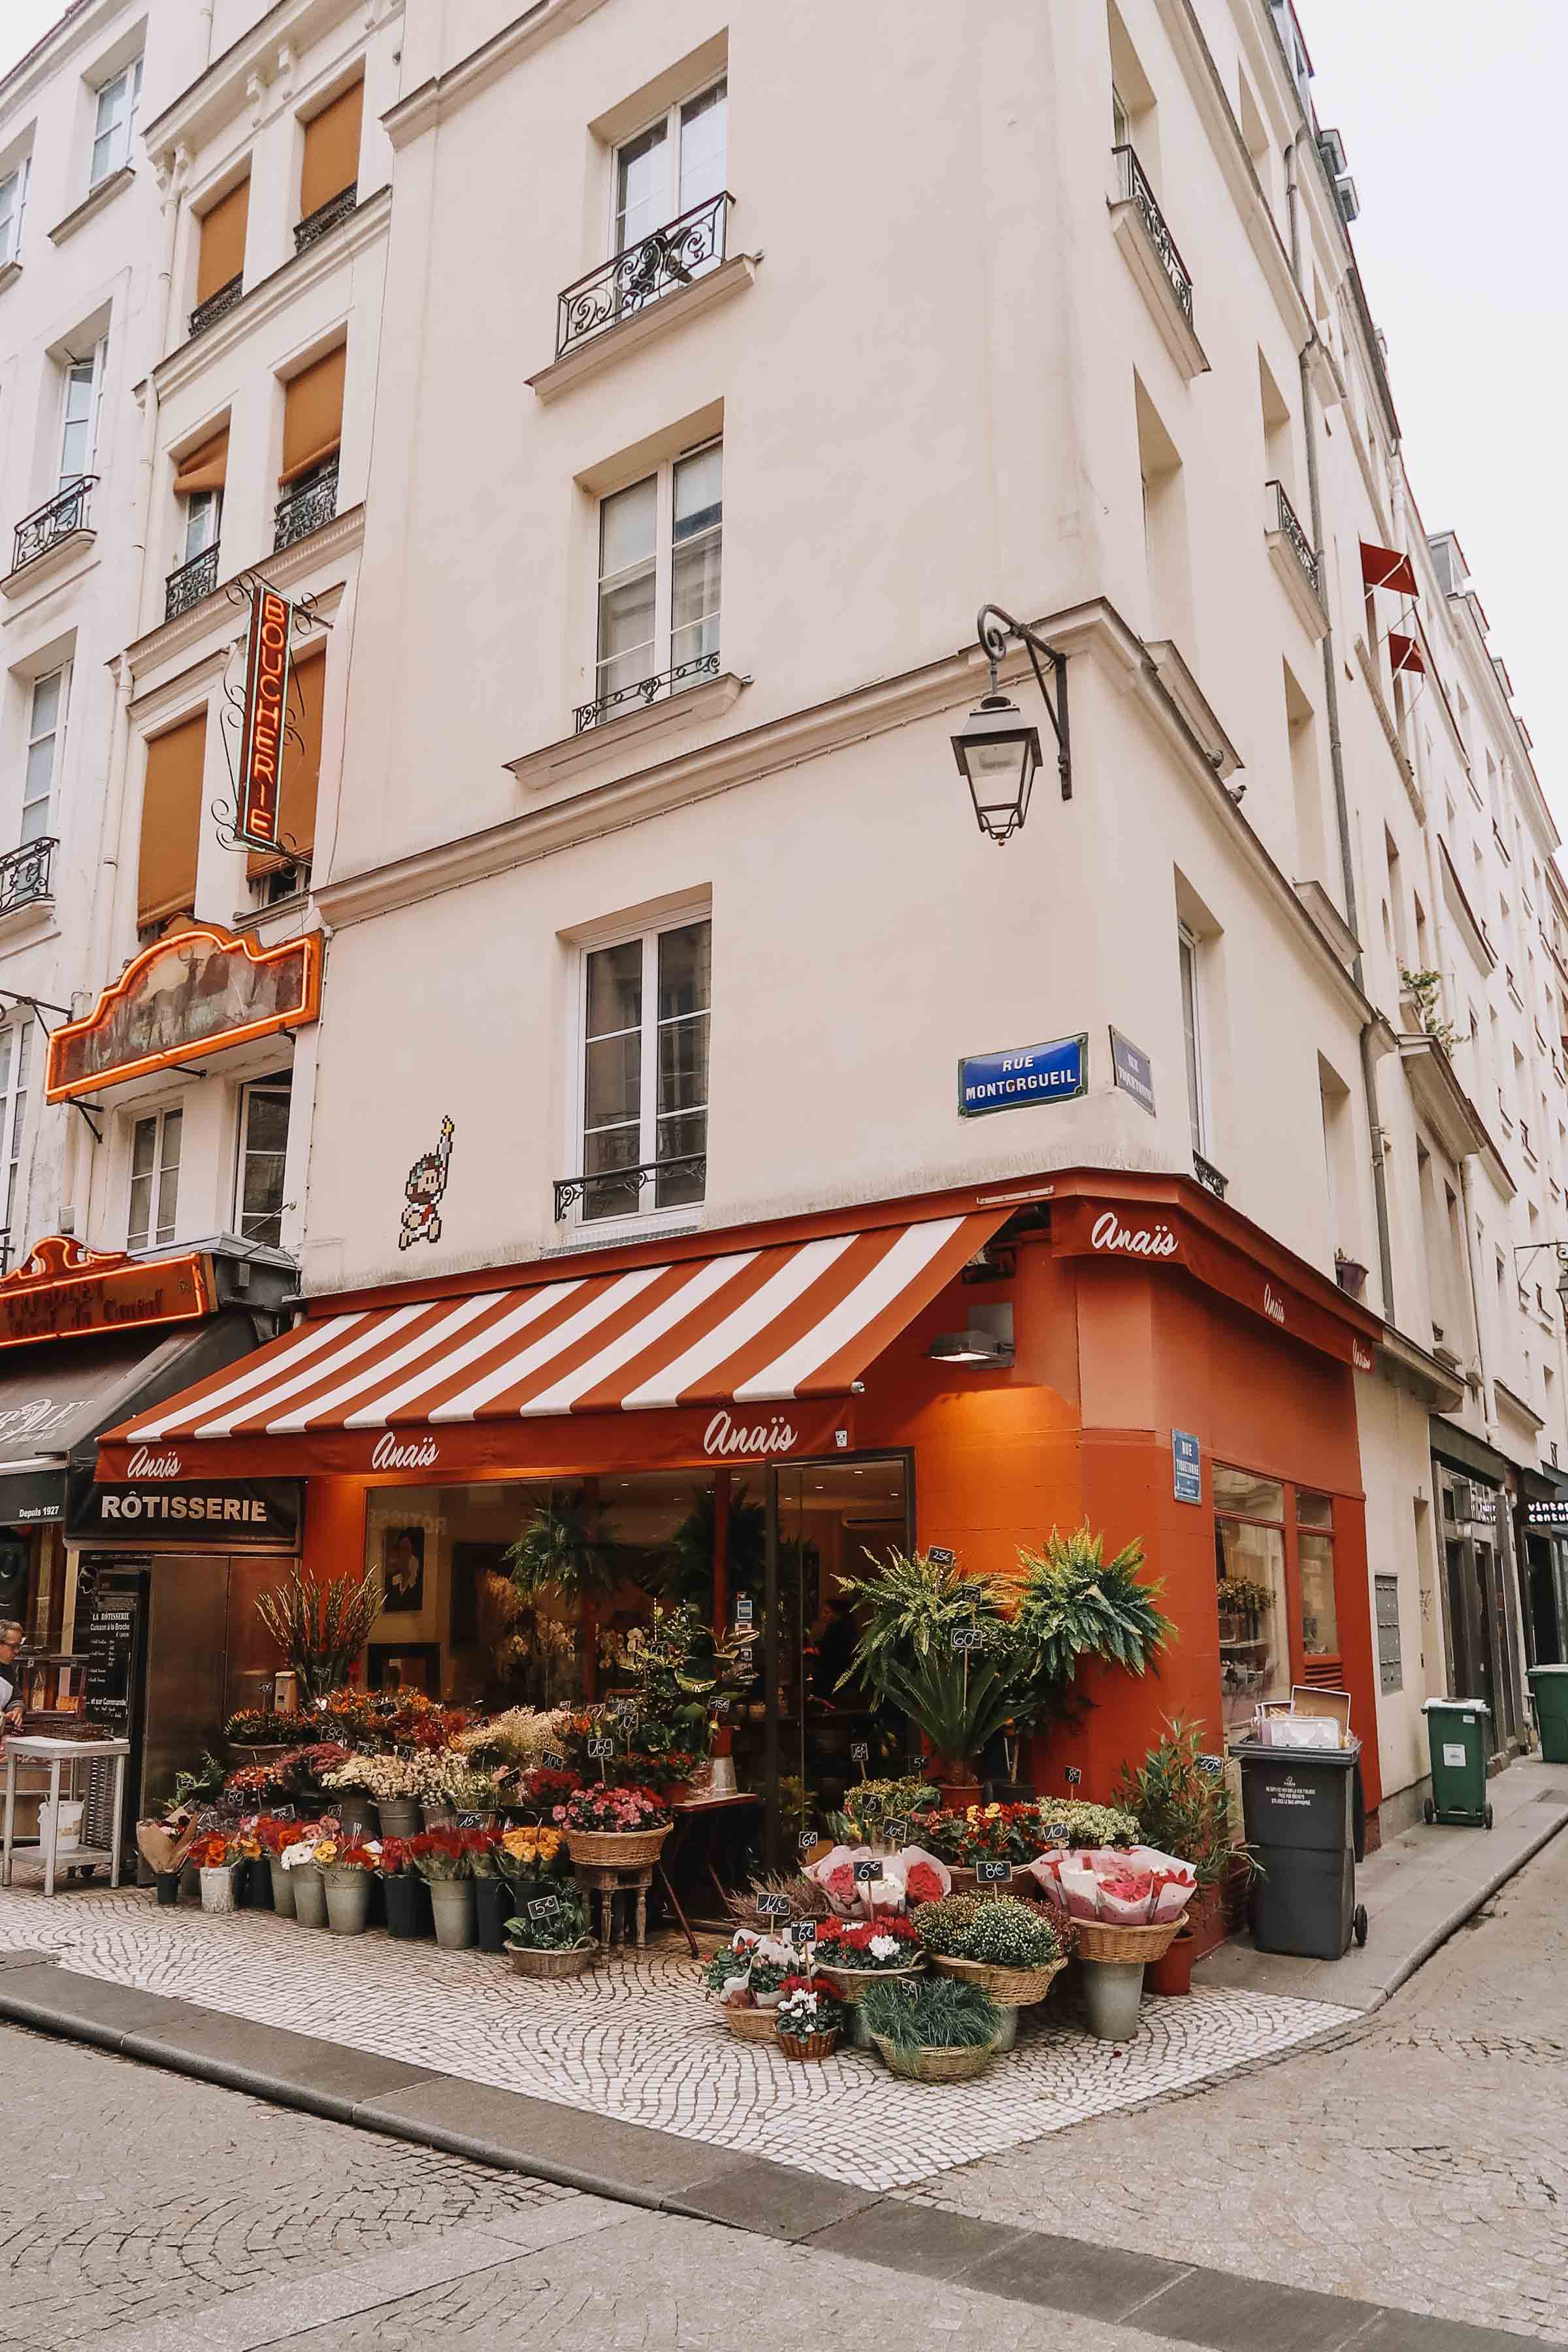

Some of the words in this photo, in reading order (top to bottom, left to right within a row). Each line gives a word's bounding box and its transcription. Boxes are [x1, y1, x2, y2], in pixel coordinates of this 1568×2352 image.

[250, 595, 285, 838] BOUCHERIE
[1002, 1054, 1034, 1072] RUE
[965, 1069, 1077, 1101] MONTORGUEIL
[1091, 1212, 1179, 1256] Anaïs
[1264, 1282, 1285, 1324] Anaïs
[704, 1411, 798, 1455] Anaïs
[372, 1431, 440, 1469] Anaïs
[1181, 1441, 1192, 1457] RUE
[127, 1445, 182, 1478] Anaïs
[19, 1508, 41, 1519] Depuis
[42, 1505, 59, 1516] 1927
[101, 1491, 267, 1522] RÔTISSERIE
[933, 1550, 951, 1562] 25€
[953, 1629, 981, 1646] 60€
[711, 1699, 730, 1708] 15€
[591, 1739, 612, 1755] 15€
[543, 1756, 563, 1769] 10€
[1068, 1769, 1079, 1782] 8€
[802, 1833, 816, 1846] 6€
[885, 1825, 905, 1837] 10€
[986, 1863, 1005, 1878] 8€
[535, 1897, 555, 1916] 5€
[759, 1895, 787, 1914] 12€
[798, 1926, 814, 1941] 6€
